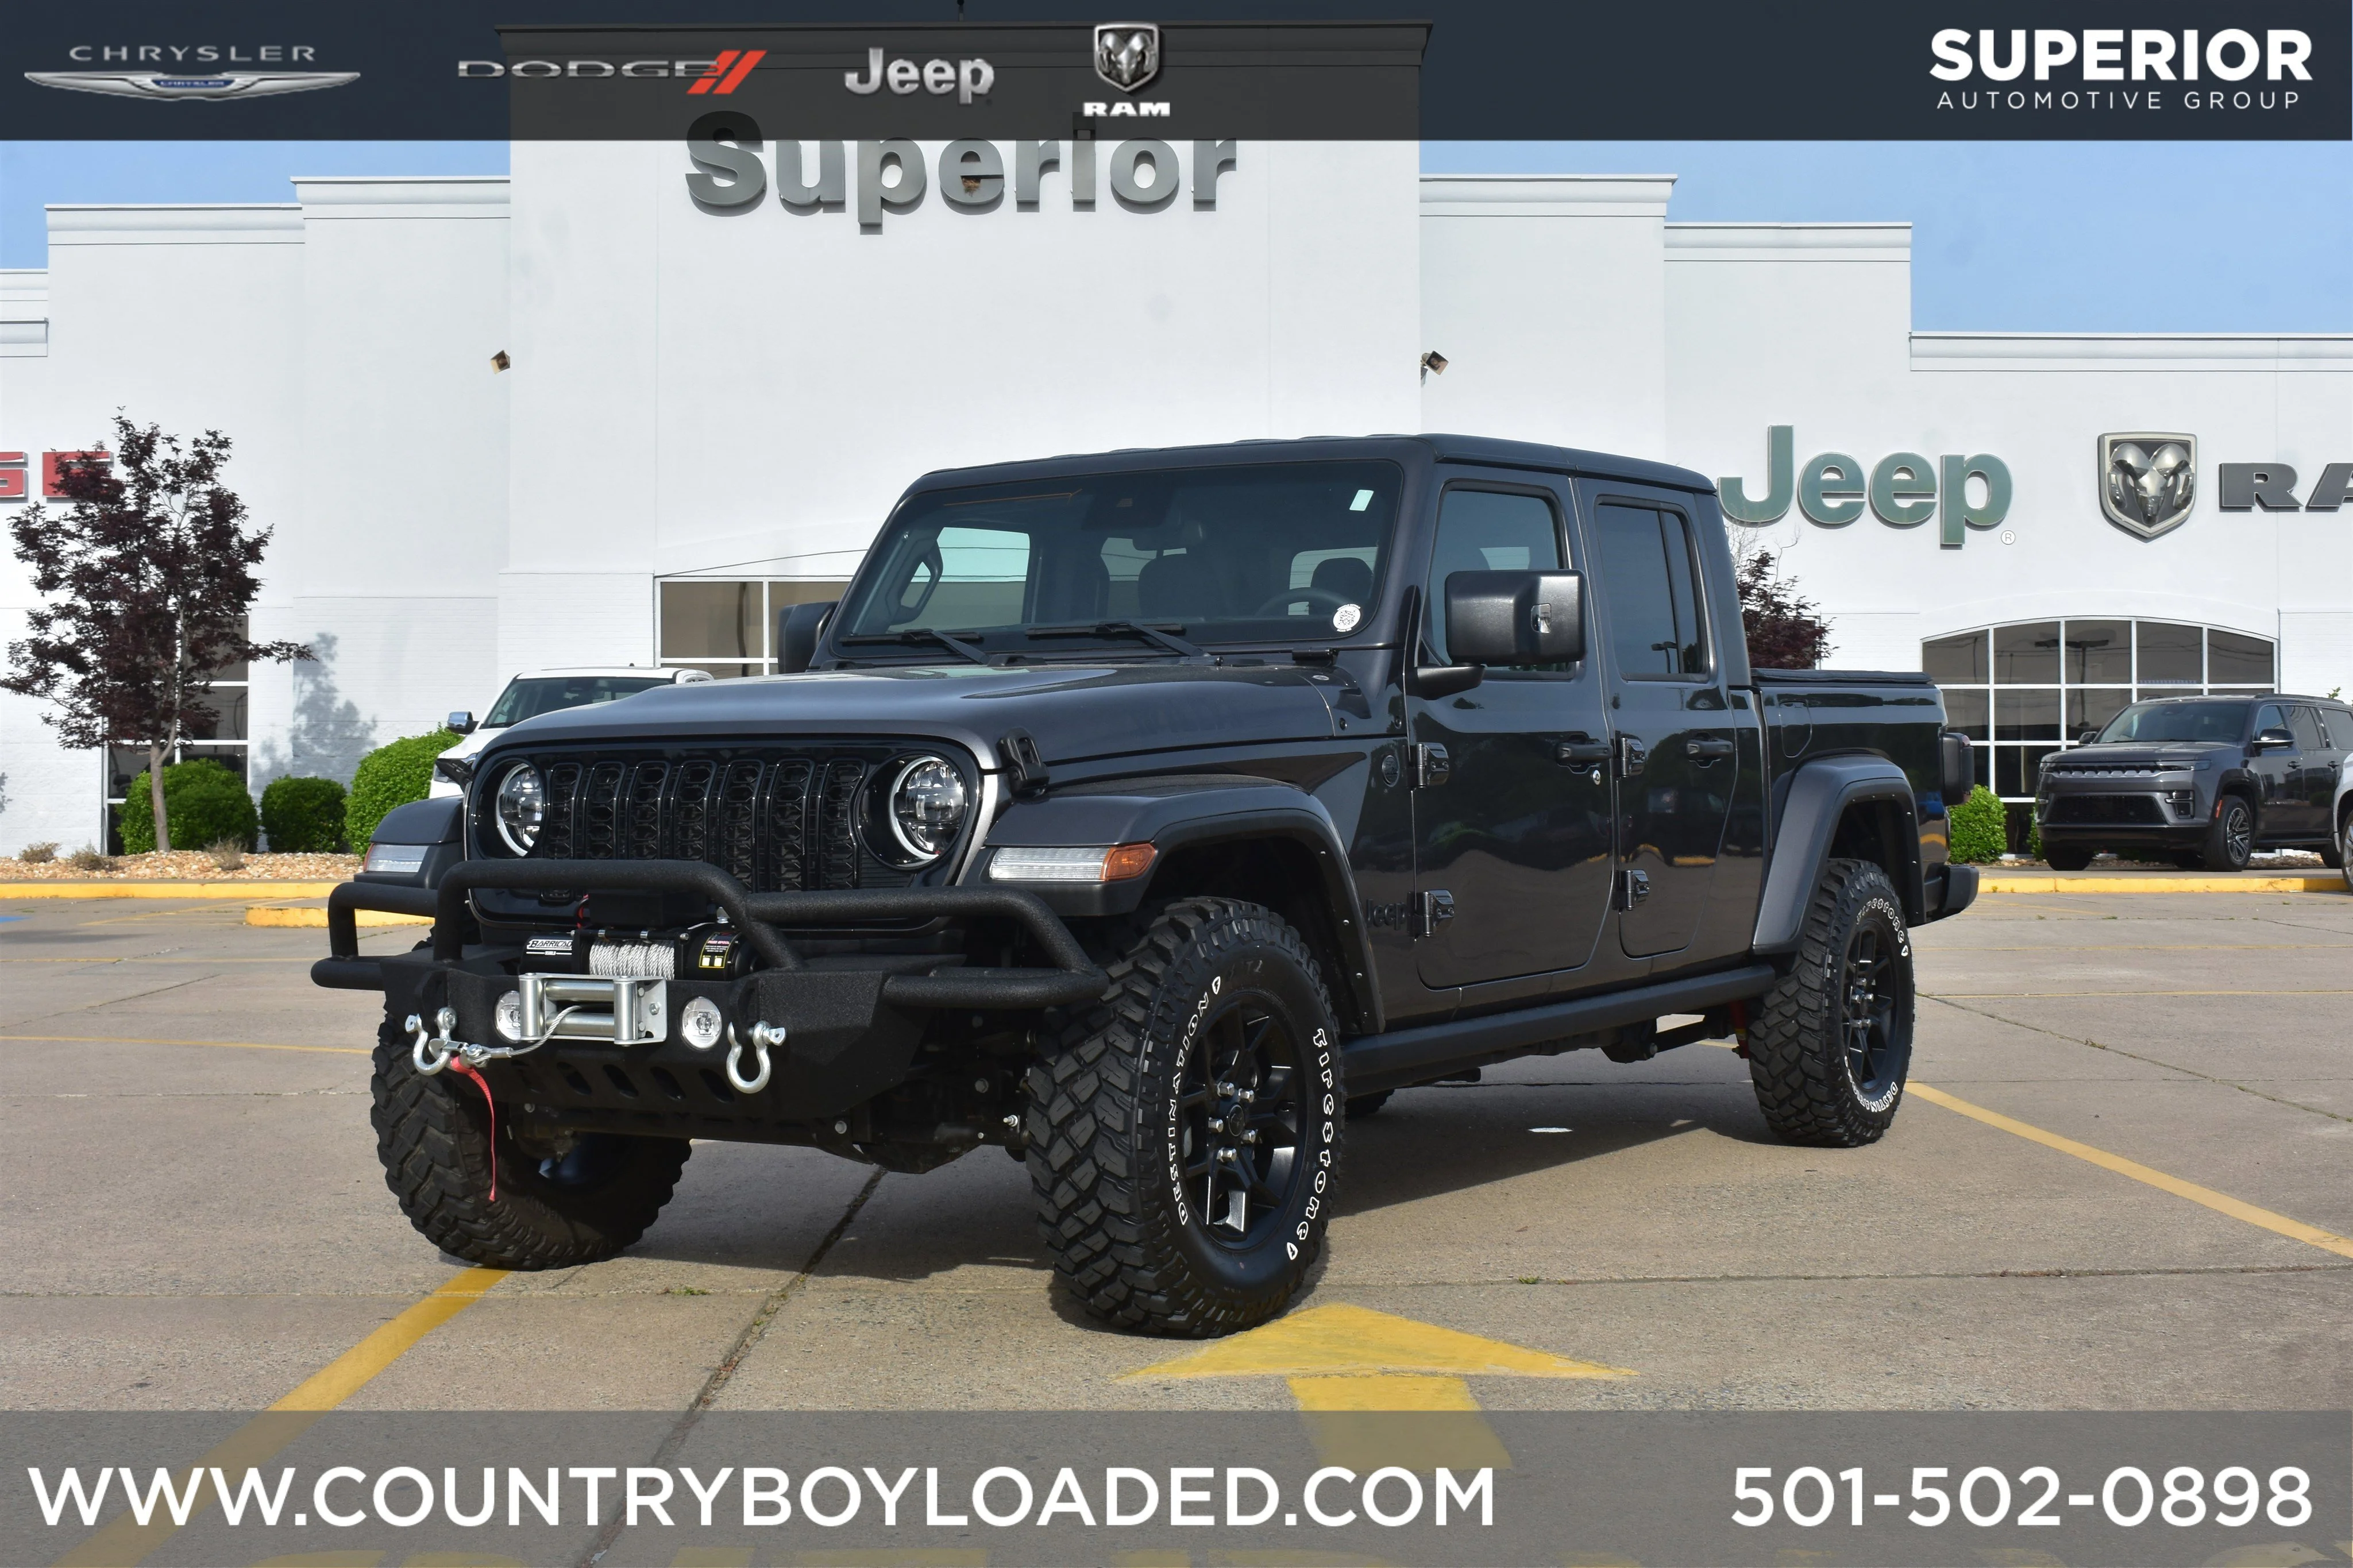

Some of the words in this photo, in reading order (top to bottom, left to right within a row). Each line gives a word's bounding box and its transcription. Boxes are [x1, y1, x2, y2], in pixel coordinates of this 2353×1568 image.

[685, 110, 1236, 227] Superior
[1718, 424, 2013, 546] Jeep
[528, 940, 572, 948] BARRICAD
[1168, 991, 1210, 1225] DESTINATION
